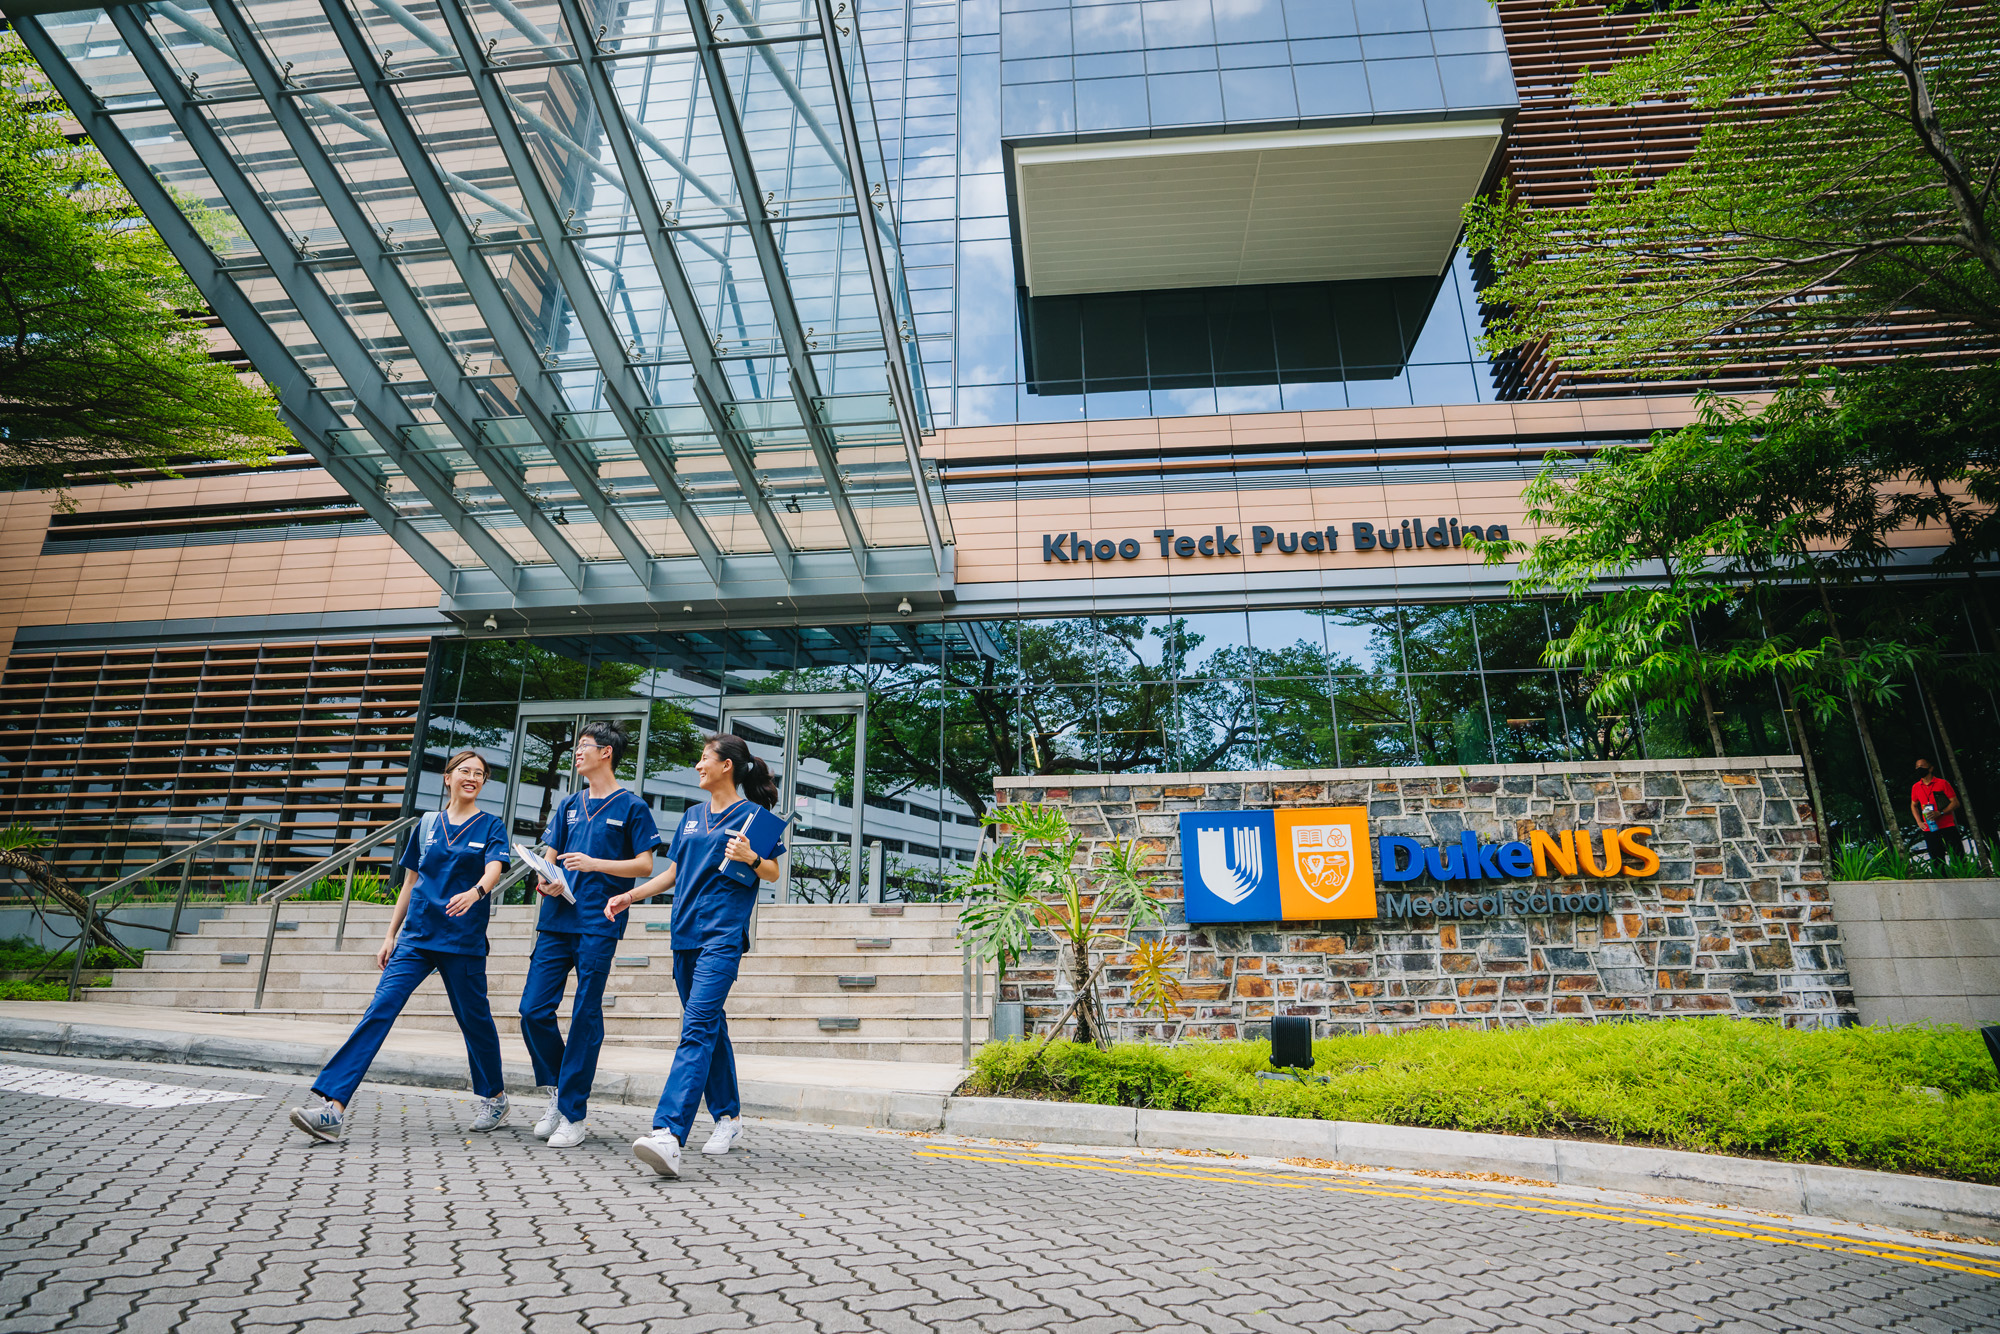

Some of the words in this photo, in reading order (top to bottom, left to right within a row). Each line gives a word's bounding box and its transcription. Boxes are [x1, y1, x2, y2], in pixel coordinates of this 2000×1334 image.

[1042, 532, 1141, 562] Khoo
[1153, 525, 1242, 558] Teck
[1252, 525, 1339, 554] Puat
[1352, 517, 1510, 552] Building
[1379, 826, 1661, 882] DukeNUS
[1386, 891, 1505, 918] Medical
[1512, 887, 1610, 915] School
[320, 1113, 330, 1125] N
[491, 1109, 502, 1120] N
